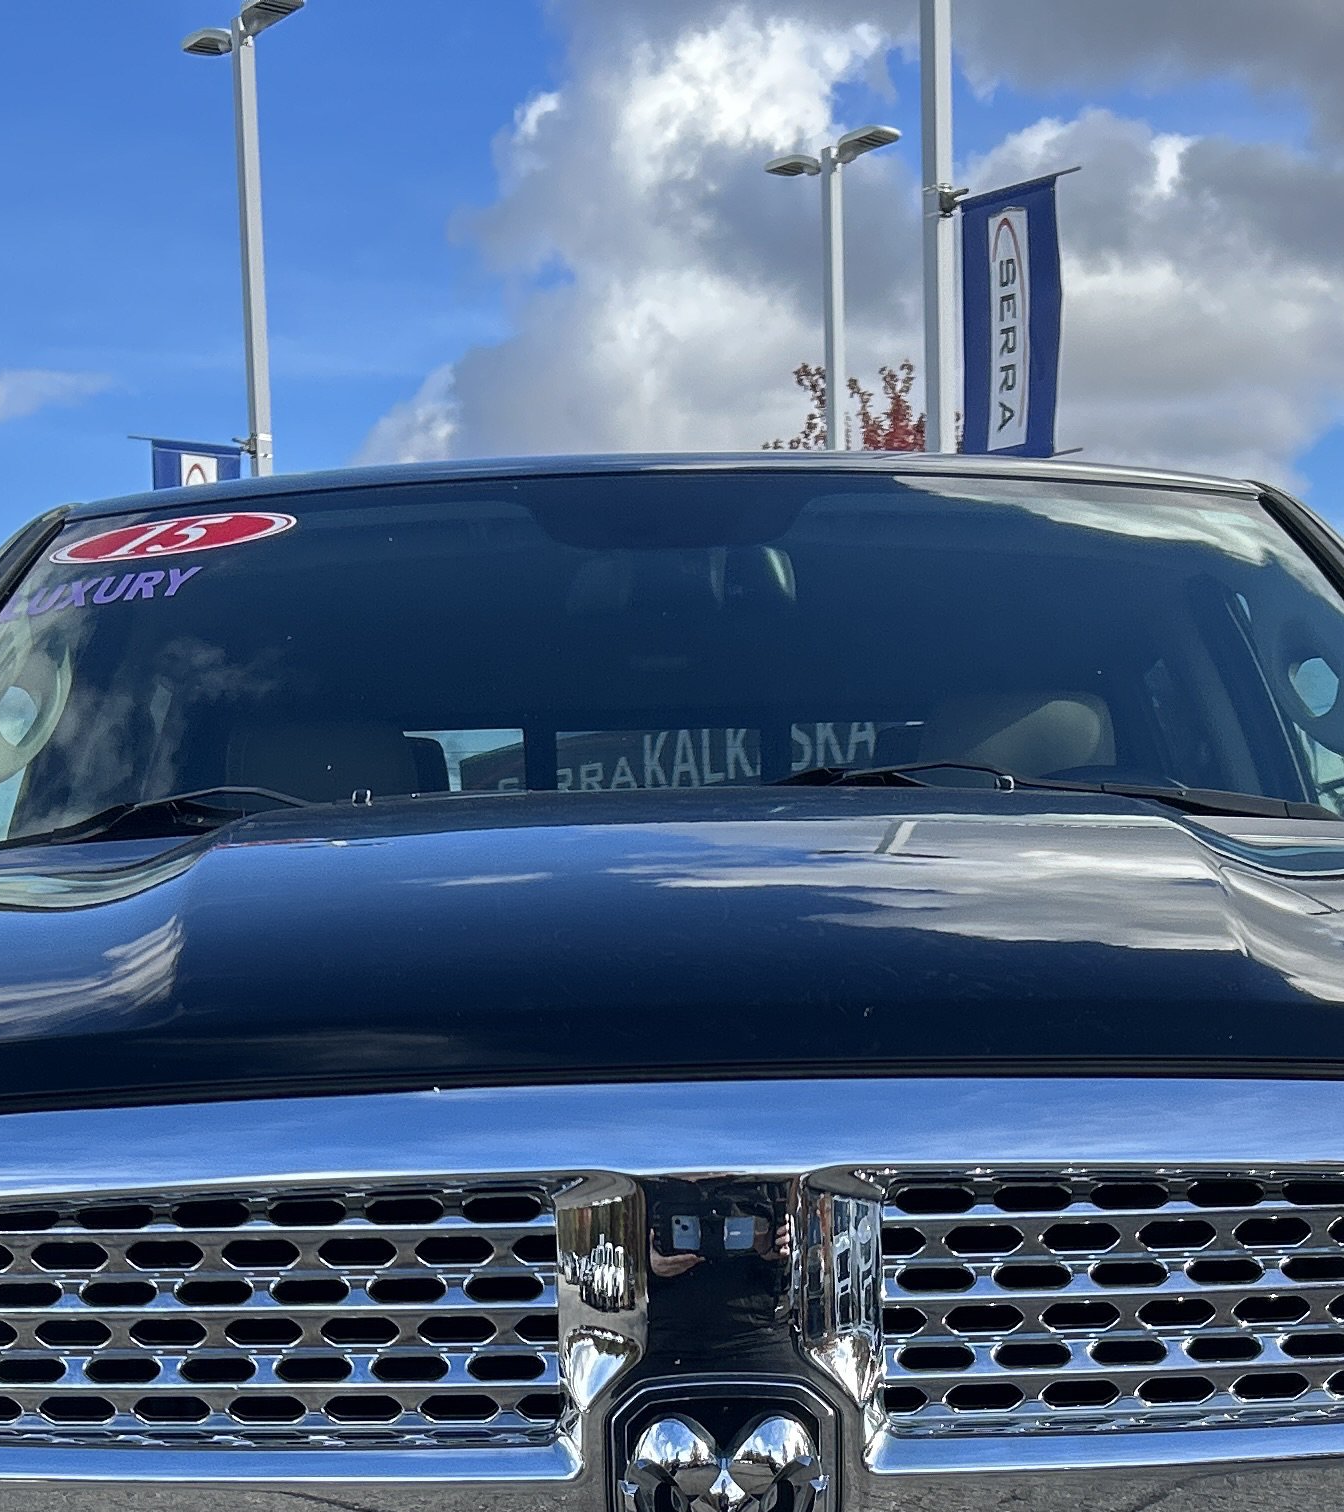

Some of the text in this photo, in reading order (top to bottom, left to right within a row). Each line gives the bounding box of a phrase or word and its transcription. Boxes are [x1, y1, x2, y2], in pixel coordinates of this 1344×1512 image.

[998, 259, 1017, 432] SERRA
[97, 516, 234, 560] 15
[0, 566, 204, 623] LUXURY
[642, 721, 877, 789] KALKSKA
